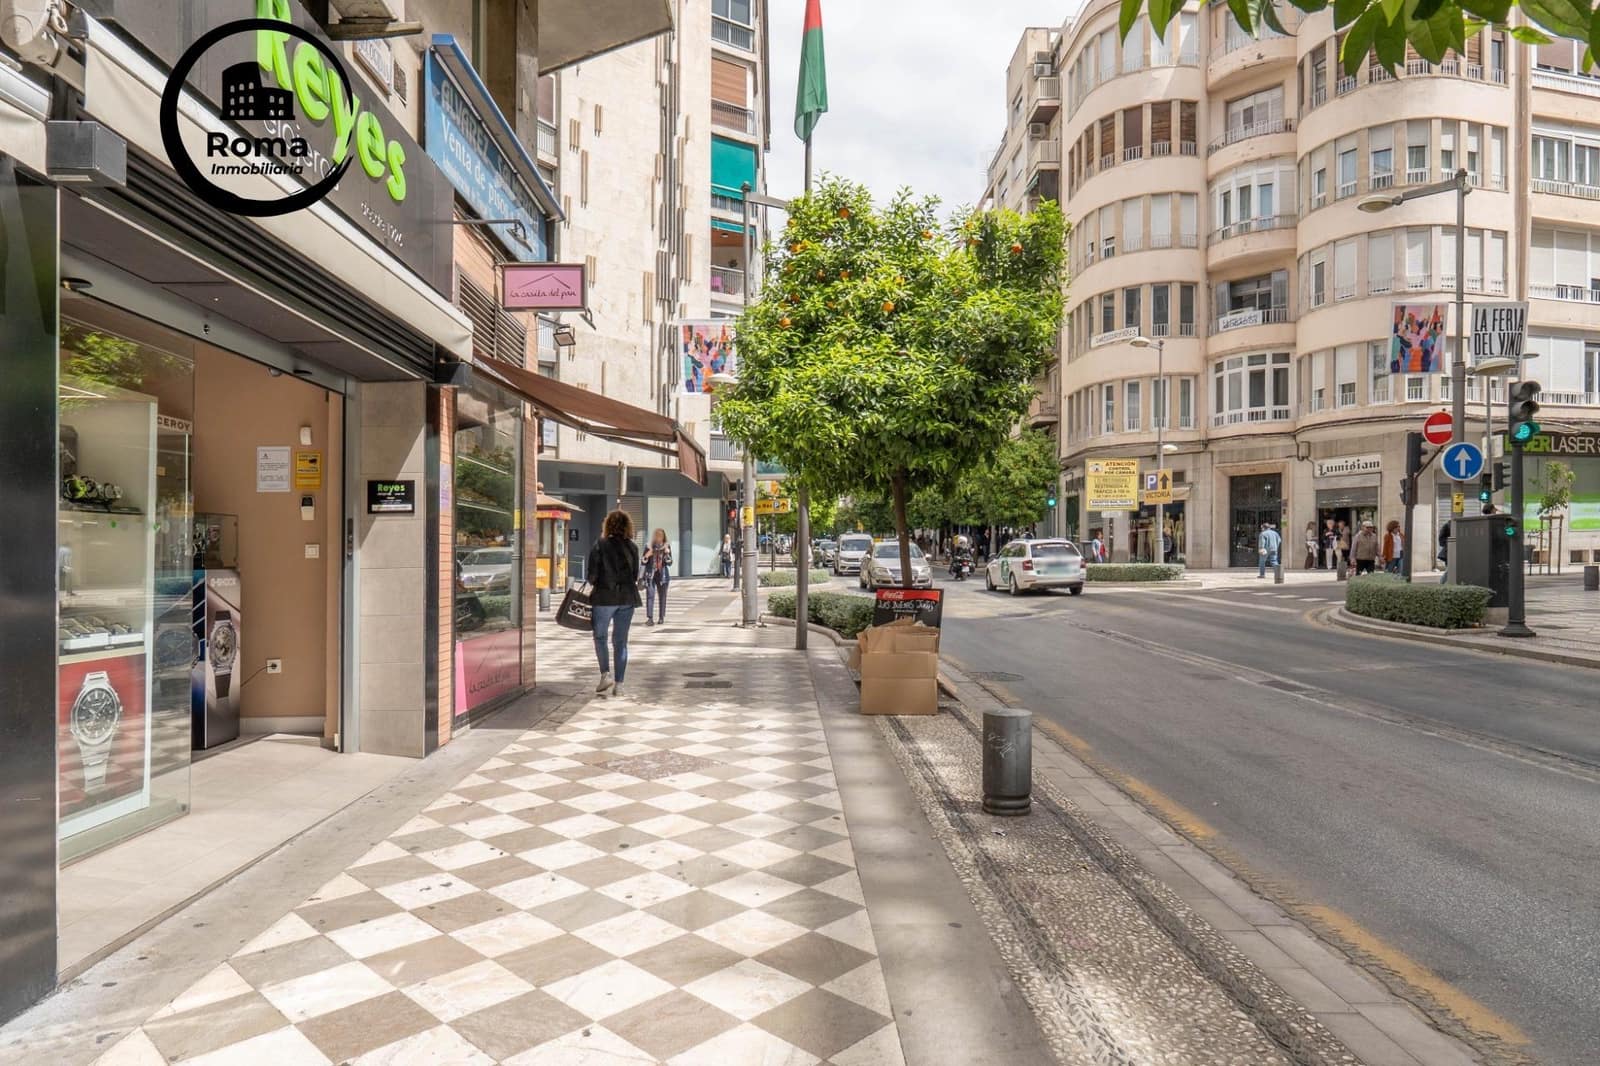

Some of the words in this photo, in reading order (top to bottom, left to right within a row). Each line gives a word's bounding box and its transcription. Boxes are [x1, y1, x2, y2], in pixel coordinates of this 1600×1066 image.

[256, 0, 407, 200] Reyes
[441, 113, 472, 174] Venta
[474, 161, 486, 190] de
[1474, 308, 1488, 332] LA
[1492, 308, 1524, 332] FERIA
[1474, 332, 1495, 356] DEL
[1499, 332, 1523, 356] VINO
[377, 483, 406, 494] Reyes
